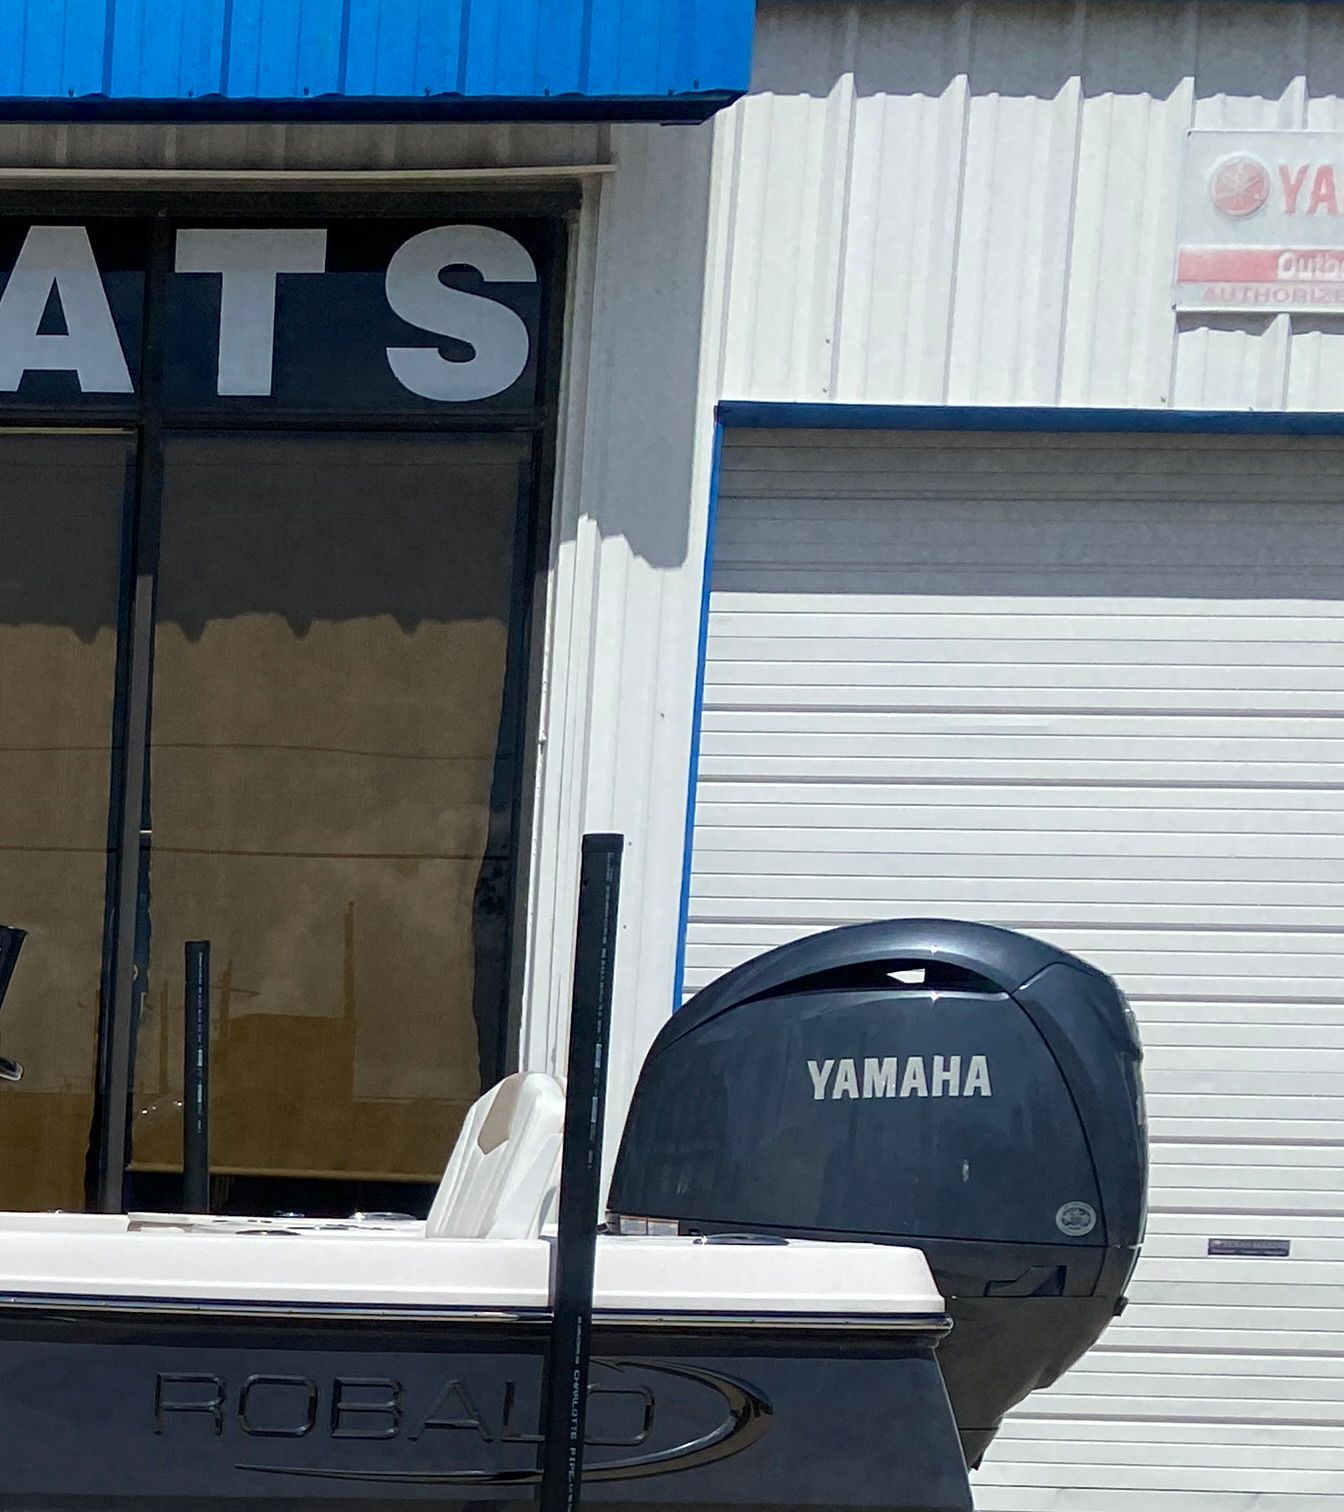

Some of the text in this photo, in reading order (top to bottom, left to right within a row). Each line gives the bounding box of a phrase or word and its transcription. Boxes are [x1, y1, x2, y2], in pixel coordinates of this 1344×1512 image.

[1278, 163, 1344, 216] YA
[807, 1055, 993, 1100] YAMAHA
[152, 1371, 656, 1447] ROBALO
